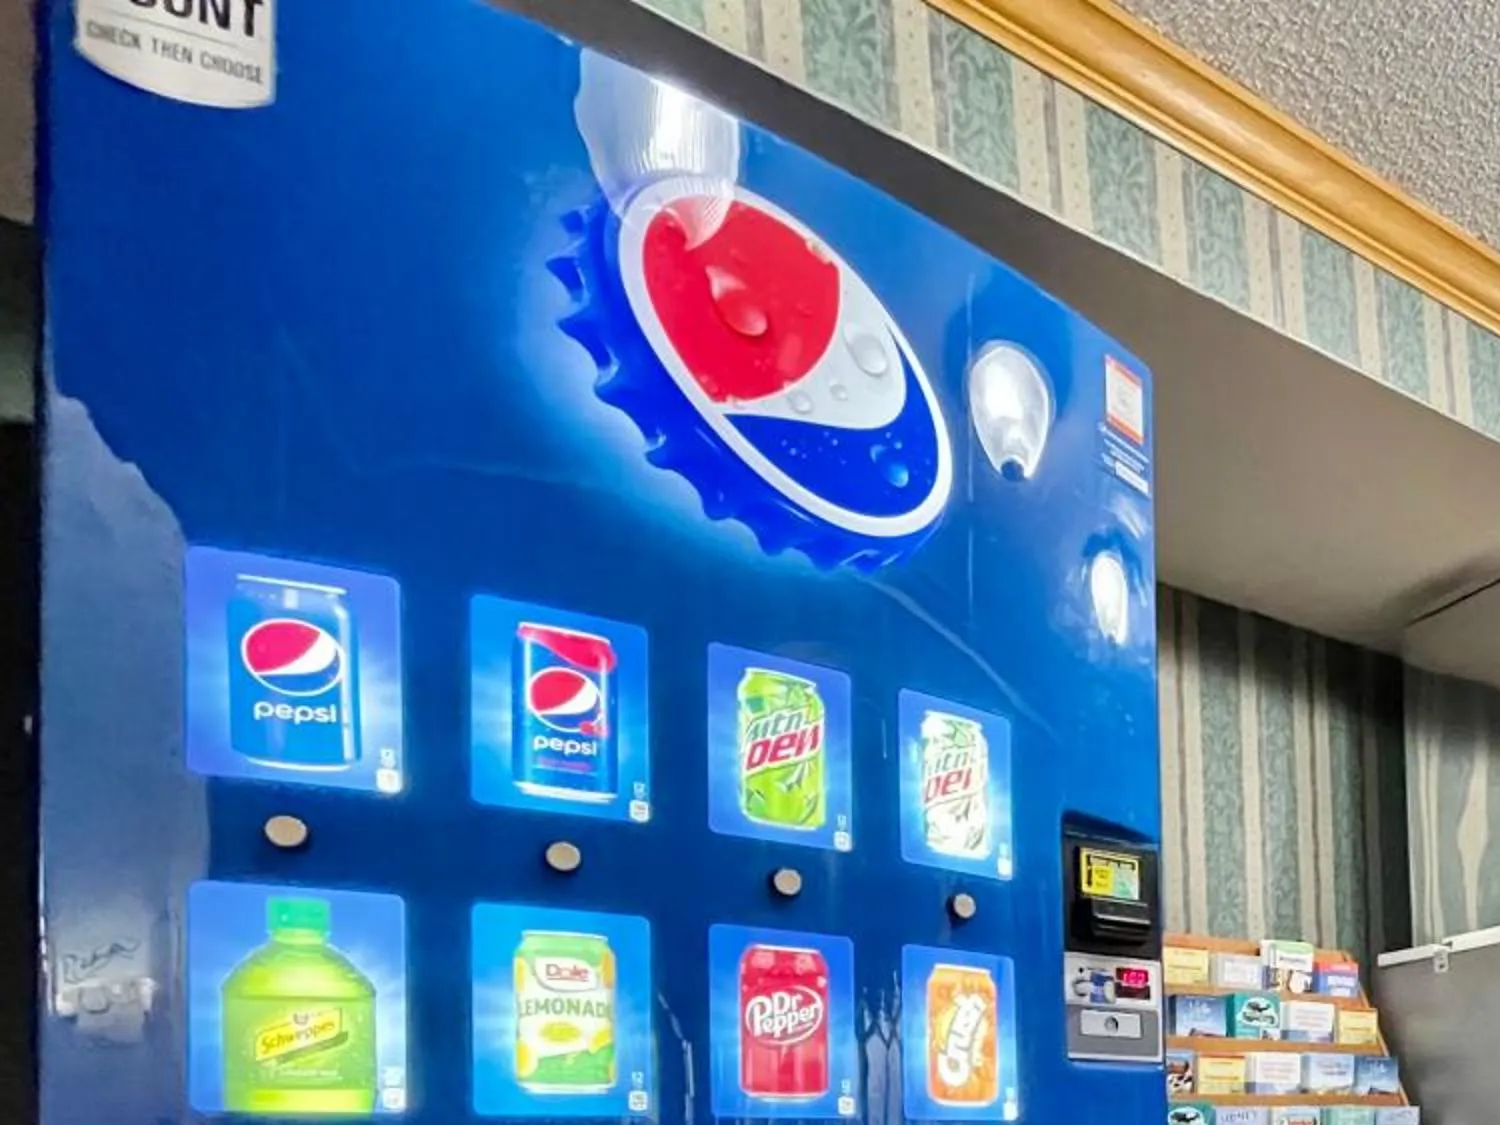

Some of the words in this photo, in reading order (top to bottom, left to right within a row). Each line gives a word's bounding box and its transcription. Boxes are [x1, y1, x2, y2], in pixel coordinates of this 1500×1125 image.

[129, 0, 263, 37] UNT
[86, 21, 141, 49] CHECK
[151, 37, 192, 64] THEN
[200, 51, 263, 83] CHOOSE
[253, 700, 337, 724] pepsi
[532, 735, 598, 756] pepsi
[545, 963, 590, 981] Dole
[753, 995, 820, 1038] Pepper
[772, 991, 804, 1012] Dr
[260, 1020, 335, 1056] Schweppes
